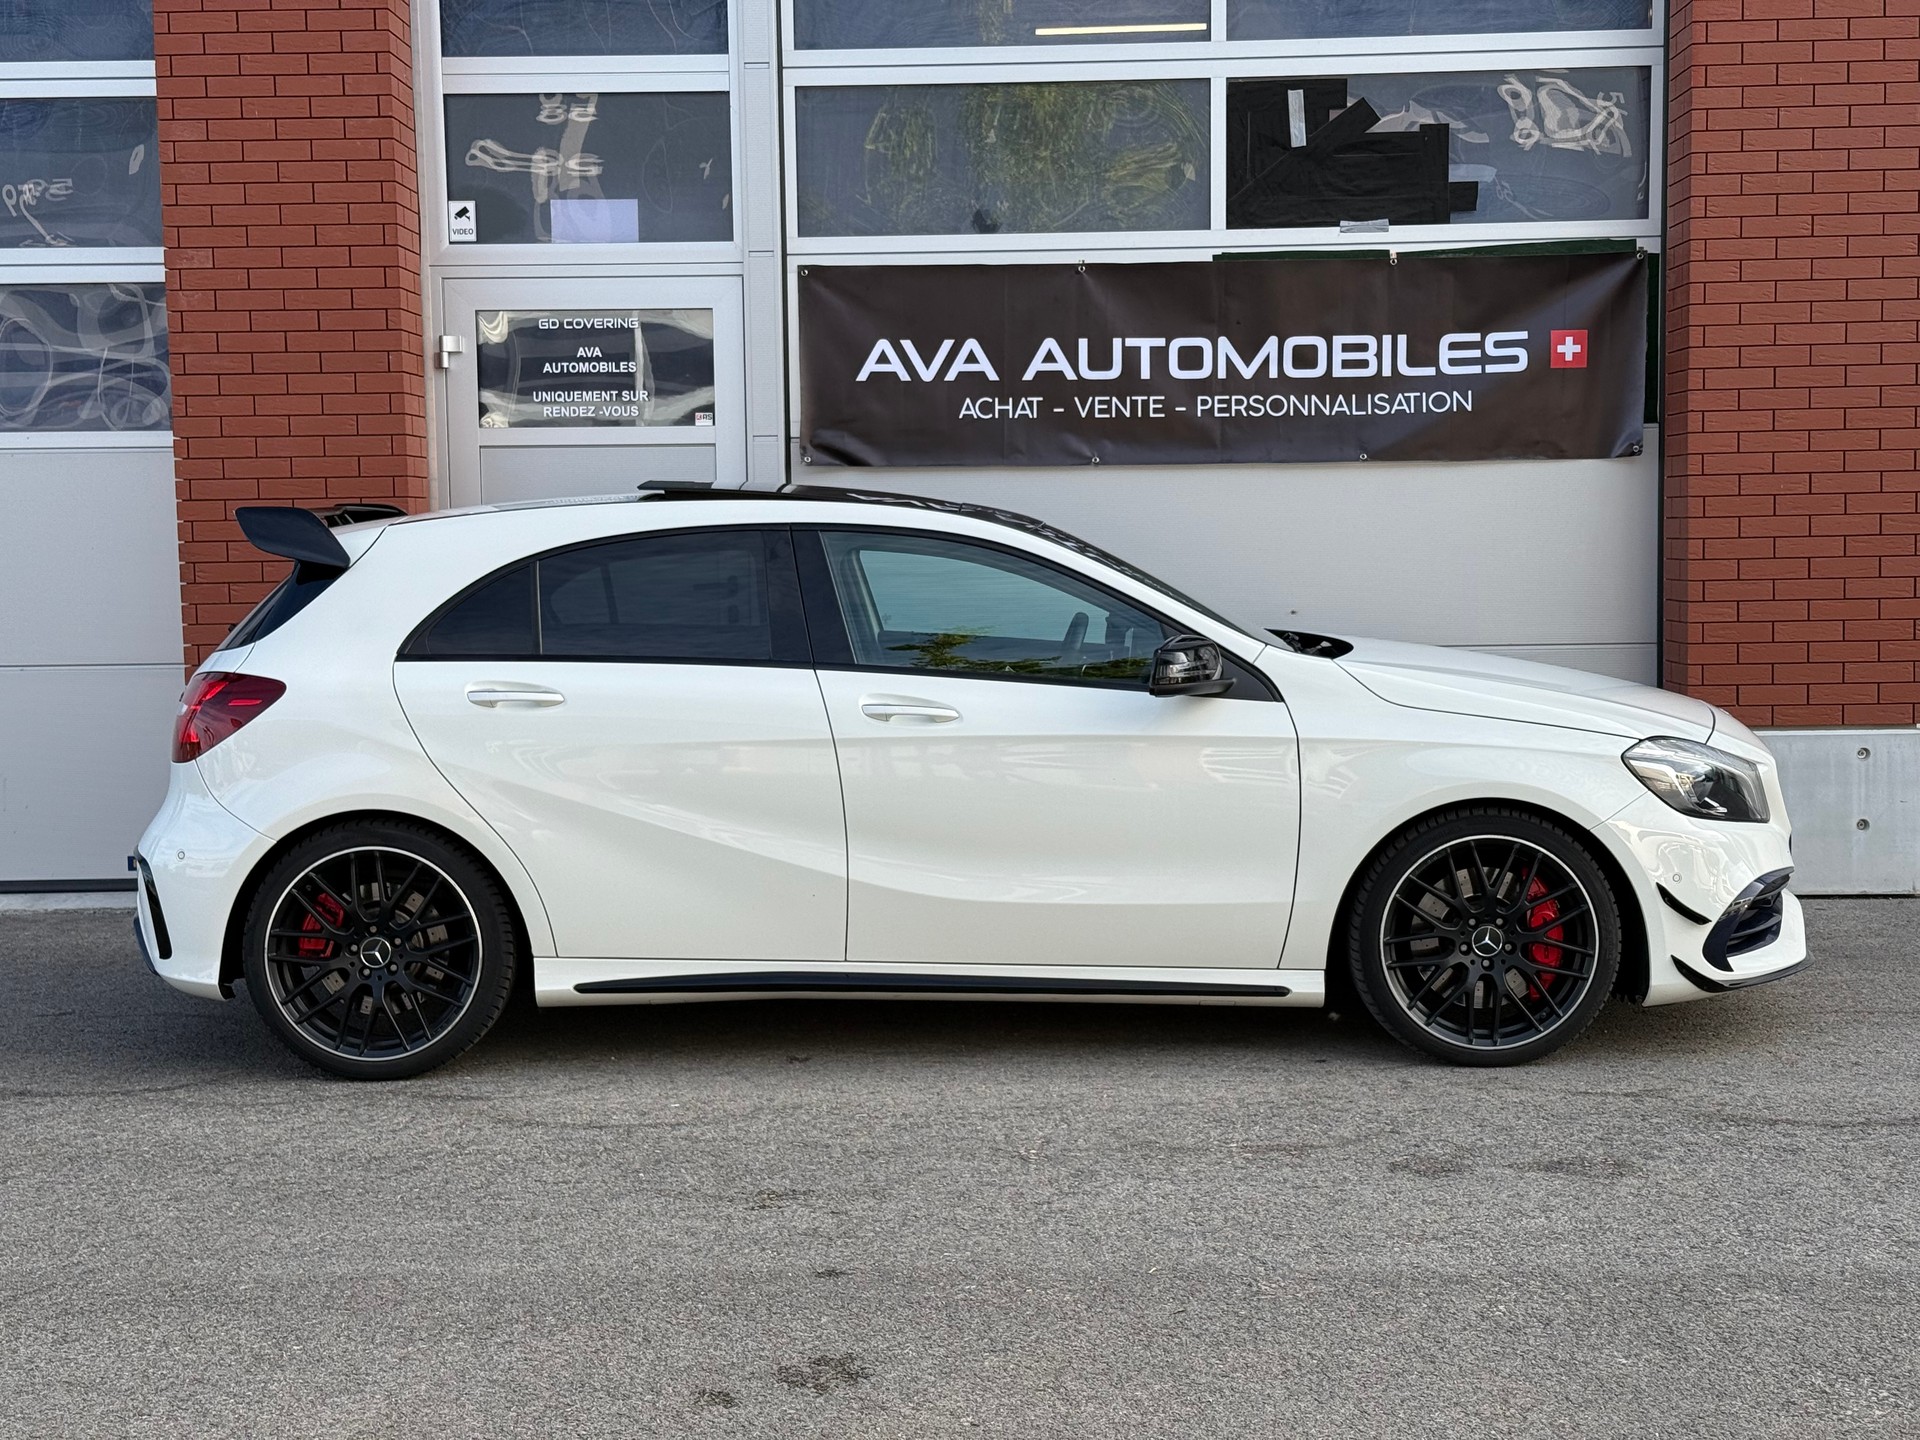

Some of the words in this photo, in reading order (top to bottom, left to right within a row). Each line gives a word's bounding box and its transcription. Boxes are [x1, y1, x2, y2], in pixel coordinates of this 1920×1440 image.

[452, 228, 474, 236] VIDEO
[538, 318, 560, 330] GD
[564, 317, 640, 329] COVERING
[576, 346, 602, 358] AVA
[855, 338, 999, 382] AVA
[1022, 331, 1530, 381] AUTOMOBILES
[543, 361, 637, 373] AUTOMOBILES
[533, 391, 619, 403] UNIQUEMENT
[622, 391, 649, 402] SUR
[958, 396, 1044, 420] ACHAT
[1075, 395, 1166, 418] VENTE
[1196, 389, 1473, 418] PERSONNALISATION
[543, 405, 596, 417] RENDEZ
[599, 405, 640, 417] -VOUS
